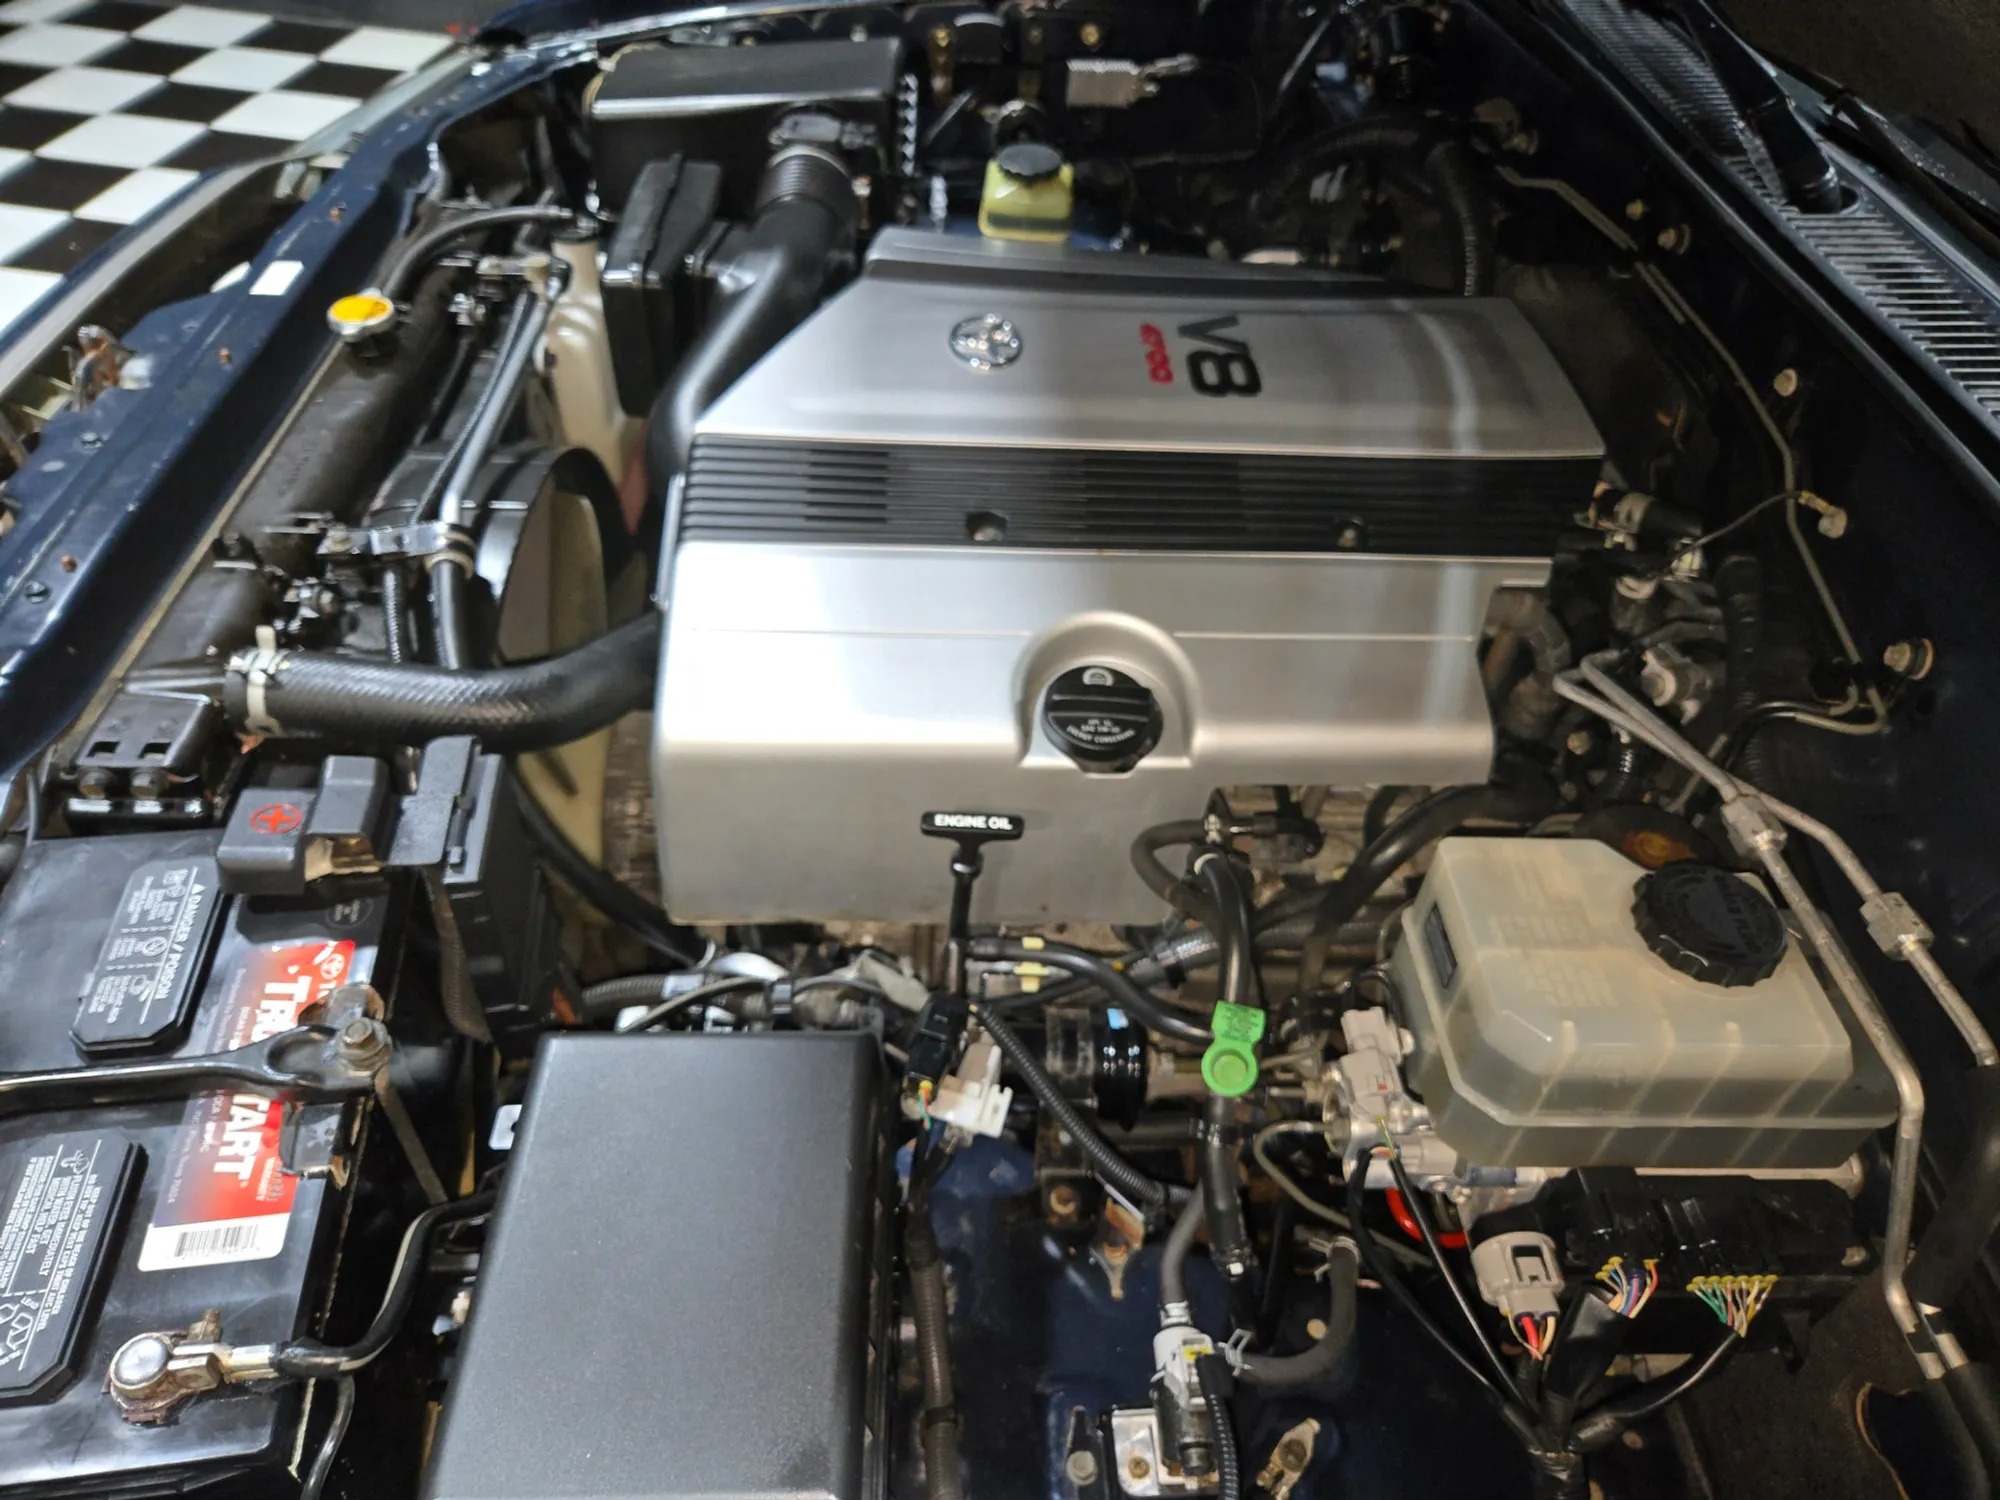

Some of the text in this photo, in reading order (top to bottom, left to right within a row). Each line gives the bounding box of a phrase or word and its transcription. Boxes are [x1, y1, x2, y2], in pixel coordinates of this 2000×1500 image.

[1177, 316, 1261, 397] V8
[934, 814, 1013, 830] ENGINE OIL
[174, 895, 203, 943] DANGER
[154, 953, 183, 1000] POISON
[56, 1176, 71, 1196] WITH
[89, 1187, 101, 1203] KEEP
[24, 1177, 61, 1254] MEDICAL HELP FAST
[37, 1175, 82, 1276] FLUSH EYES IMMEDIATELY
[70, 1213, 84, 1231] KEEP
[38, 1229, 52, 1244] GET
[64, 1232, 77, 1249] VENT
[66, 1243, 82, 1266] REACH
[35, 1309, 50, 1332] LEVEL
